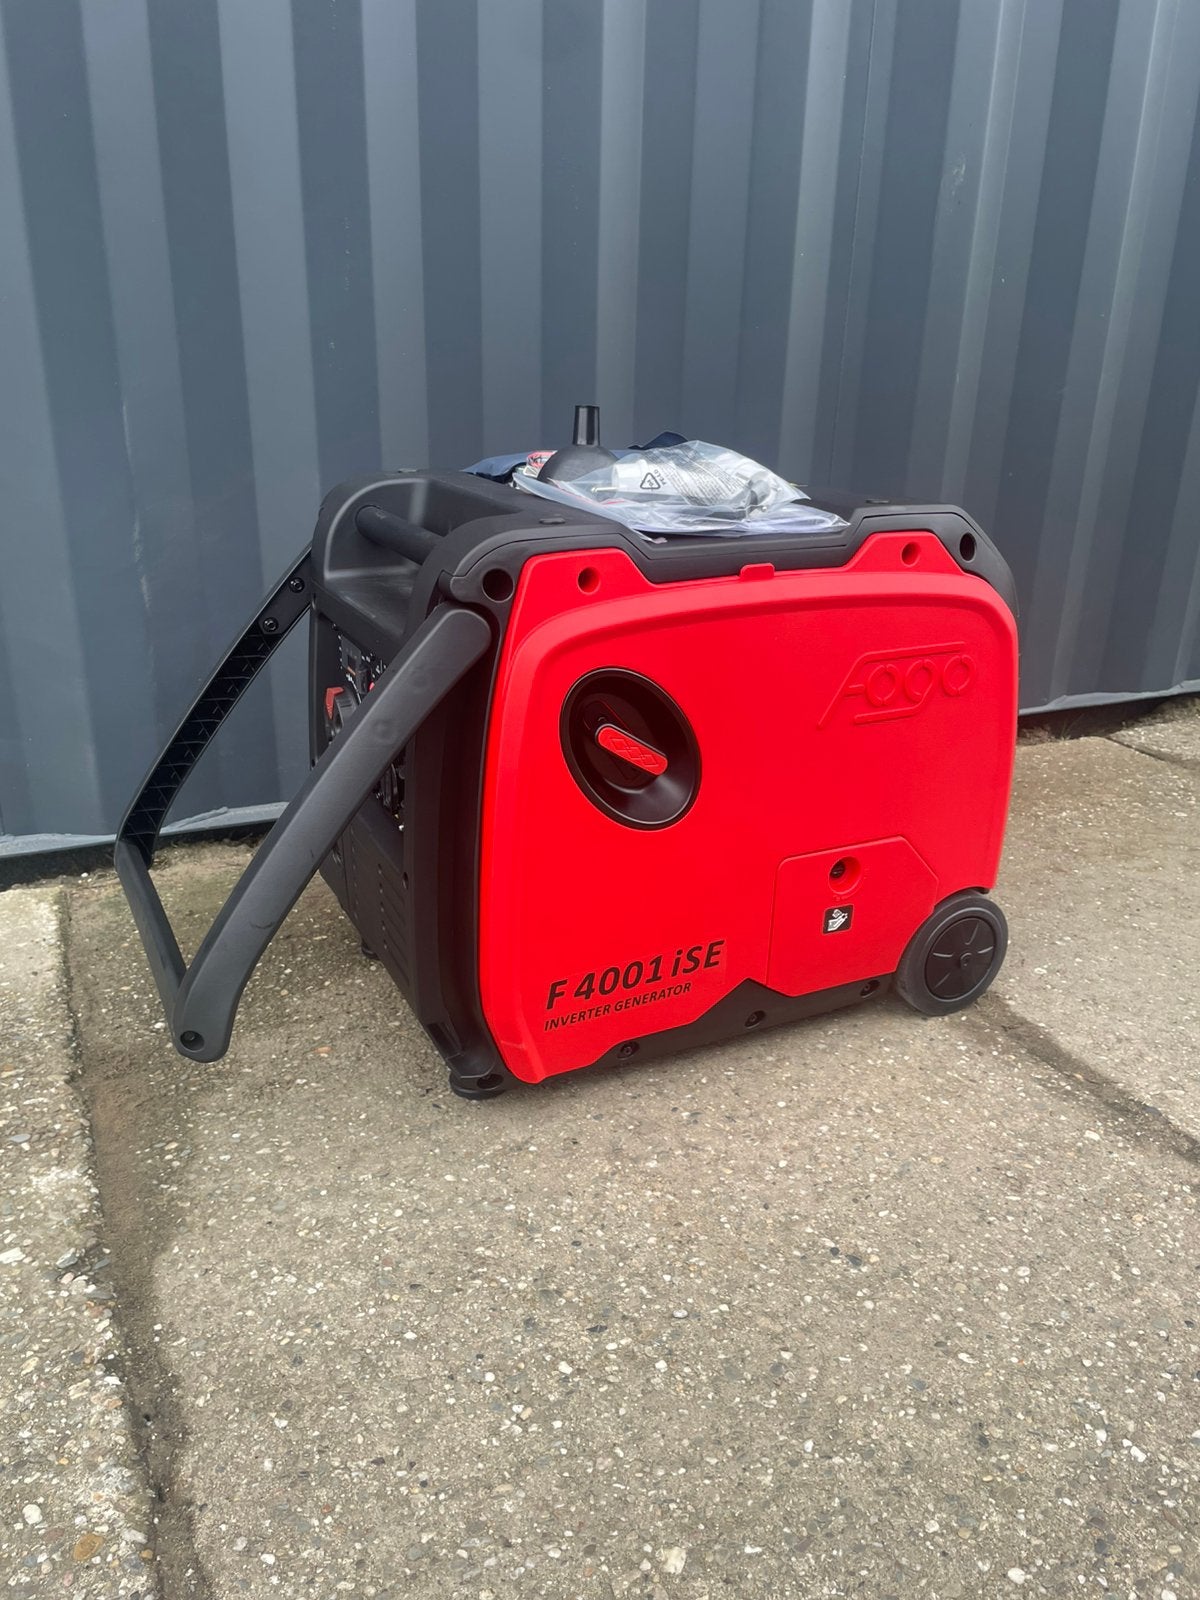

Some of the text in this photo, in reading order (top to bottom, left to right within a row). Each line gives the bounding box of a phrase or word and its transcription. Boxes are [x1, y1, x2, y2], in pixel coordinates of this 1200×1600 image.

[546, 939, 725, 1010] F 4001 iSE
[544, 982, 691, 1031] INVERTER GENERATOR
